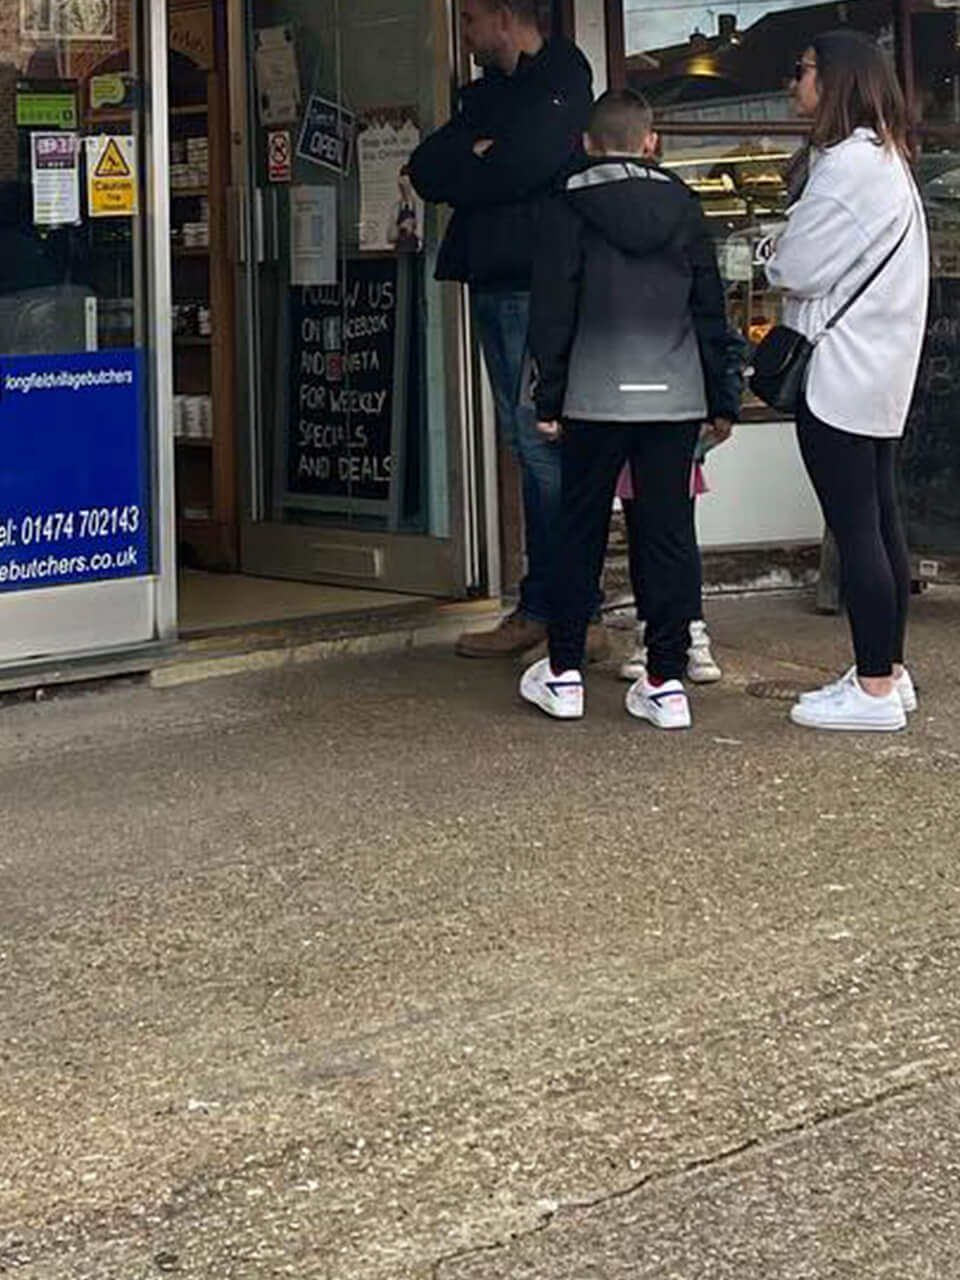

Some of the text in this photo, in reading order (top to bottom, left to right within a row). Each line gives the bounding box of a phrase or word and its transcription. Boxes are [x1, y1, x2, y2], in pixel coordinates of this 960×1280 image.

[368, 281, 394, 310] US
[299, 384, 325, 410] FOR
[298, 453, 396, 484] AND DEALS
[21, 510, 74, 545] 01474
[79, 505, 139, 537] 702143
